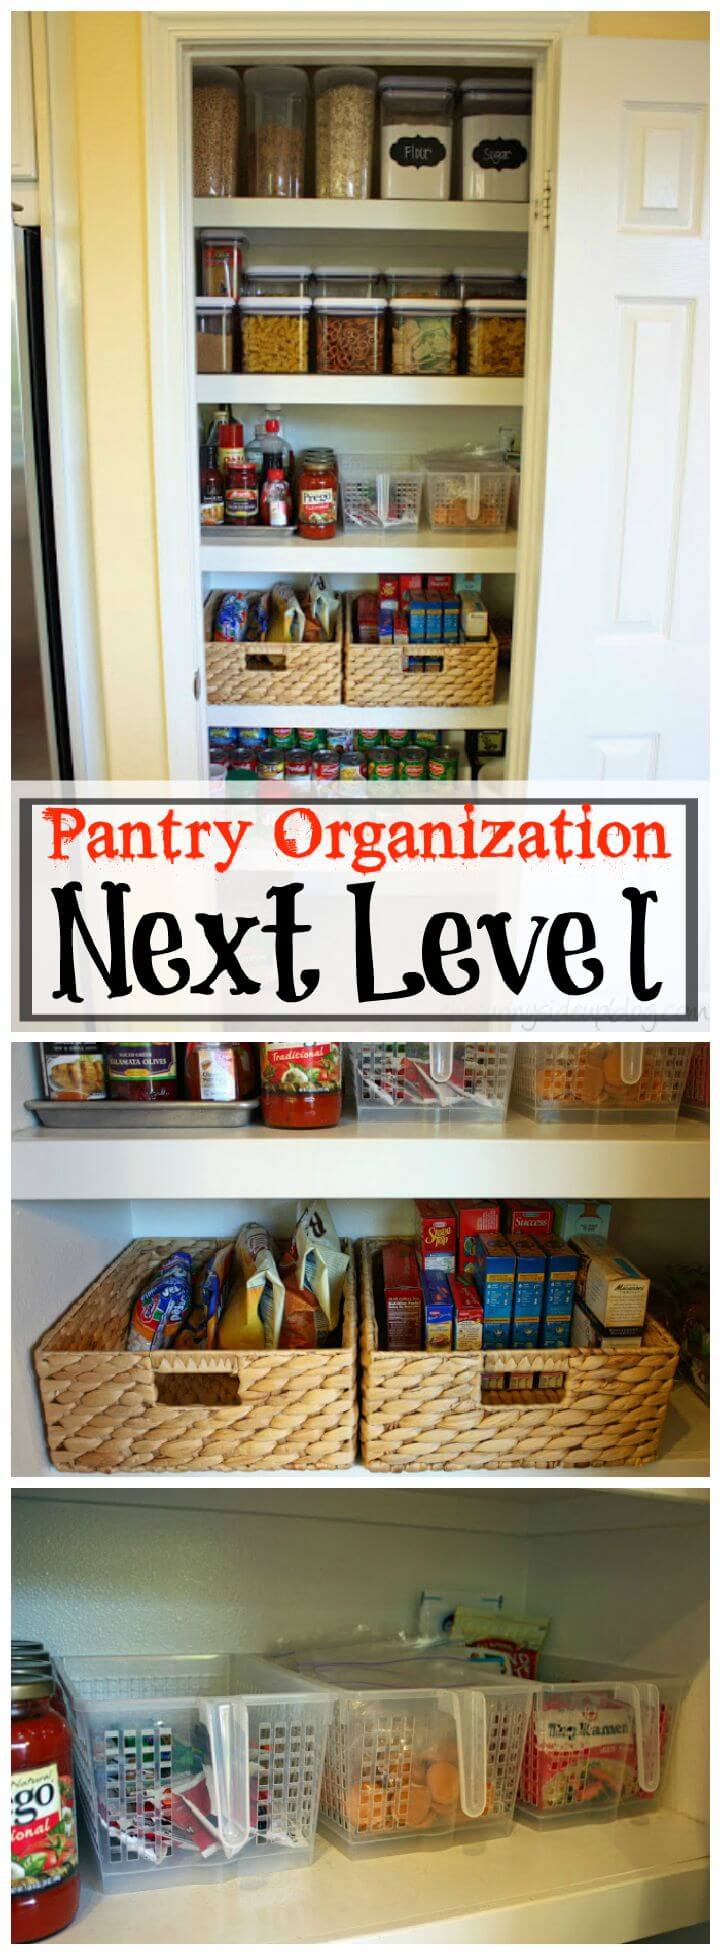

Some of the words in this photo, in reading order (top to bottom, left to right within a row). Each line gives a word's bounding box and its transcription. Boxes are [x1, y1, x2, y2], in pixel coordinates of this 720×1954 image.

[404, 145, 432, 160] Flour
[483, 147, 513, 165] Sugar
[303, 492, 331, 502] Prego
[272, 1047, 323, 1062] Traditional
[513, 1217, 548, 1227] Success
[580, 1721, 630, 1736] Ramen
